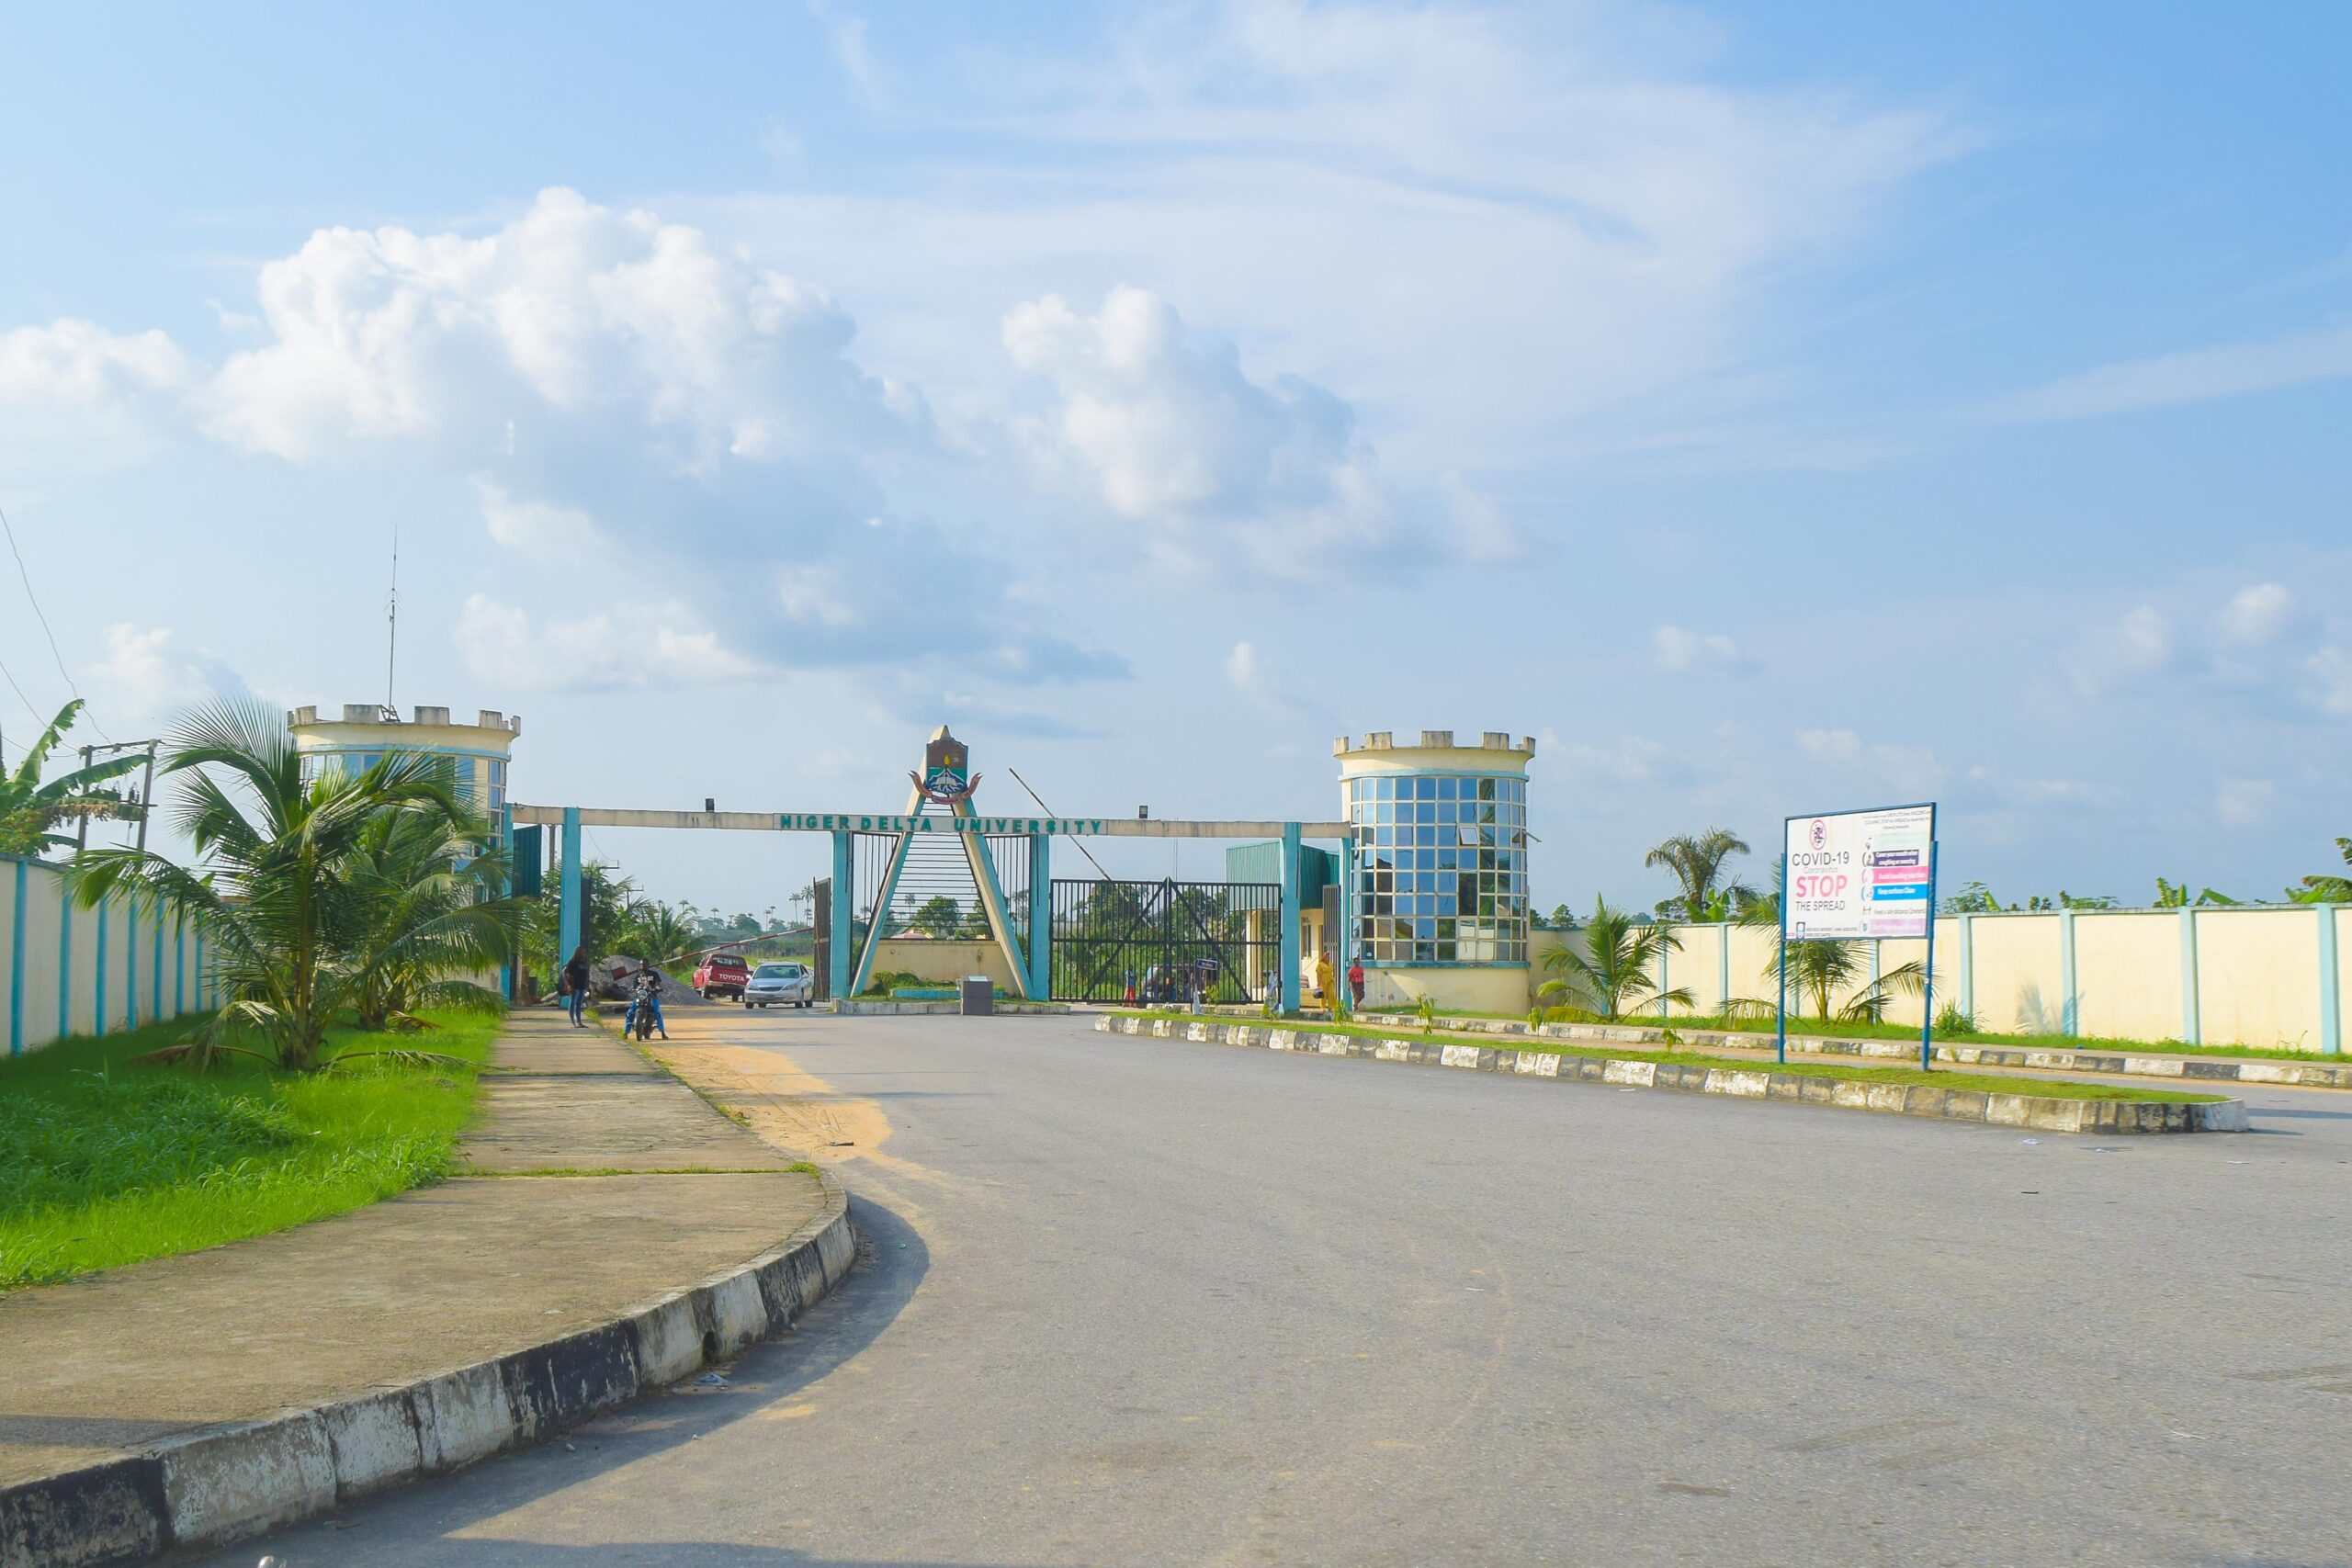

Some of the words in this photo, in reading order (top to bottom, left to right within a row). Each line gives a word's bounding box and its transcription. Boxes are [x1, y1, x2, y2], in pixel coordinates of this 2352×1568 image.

[781, 815, 850, 829] NIGER
[860, 817, 933, 831] DELTA
[954, 818, 1102, 834] UNIVERSITY
[1792, 852, 1849, 866] COVID-19
[1796, 874, 1848, 897] STOP
[1795, 901, 1811, 911] THE
[1813, 900, 1846, 911] SPREAD
[718, 973, 745, 982] TOYOTA
